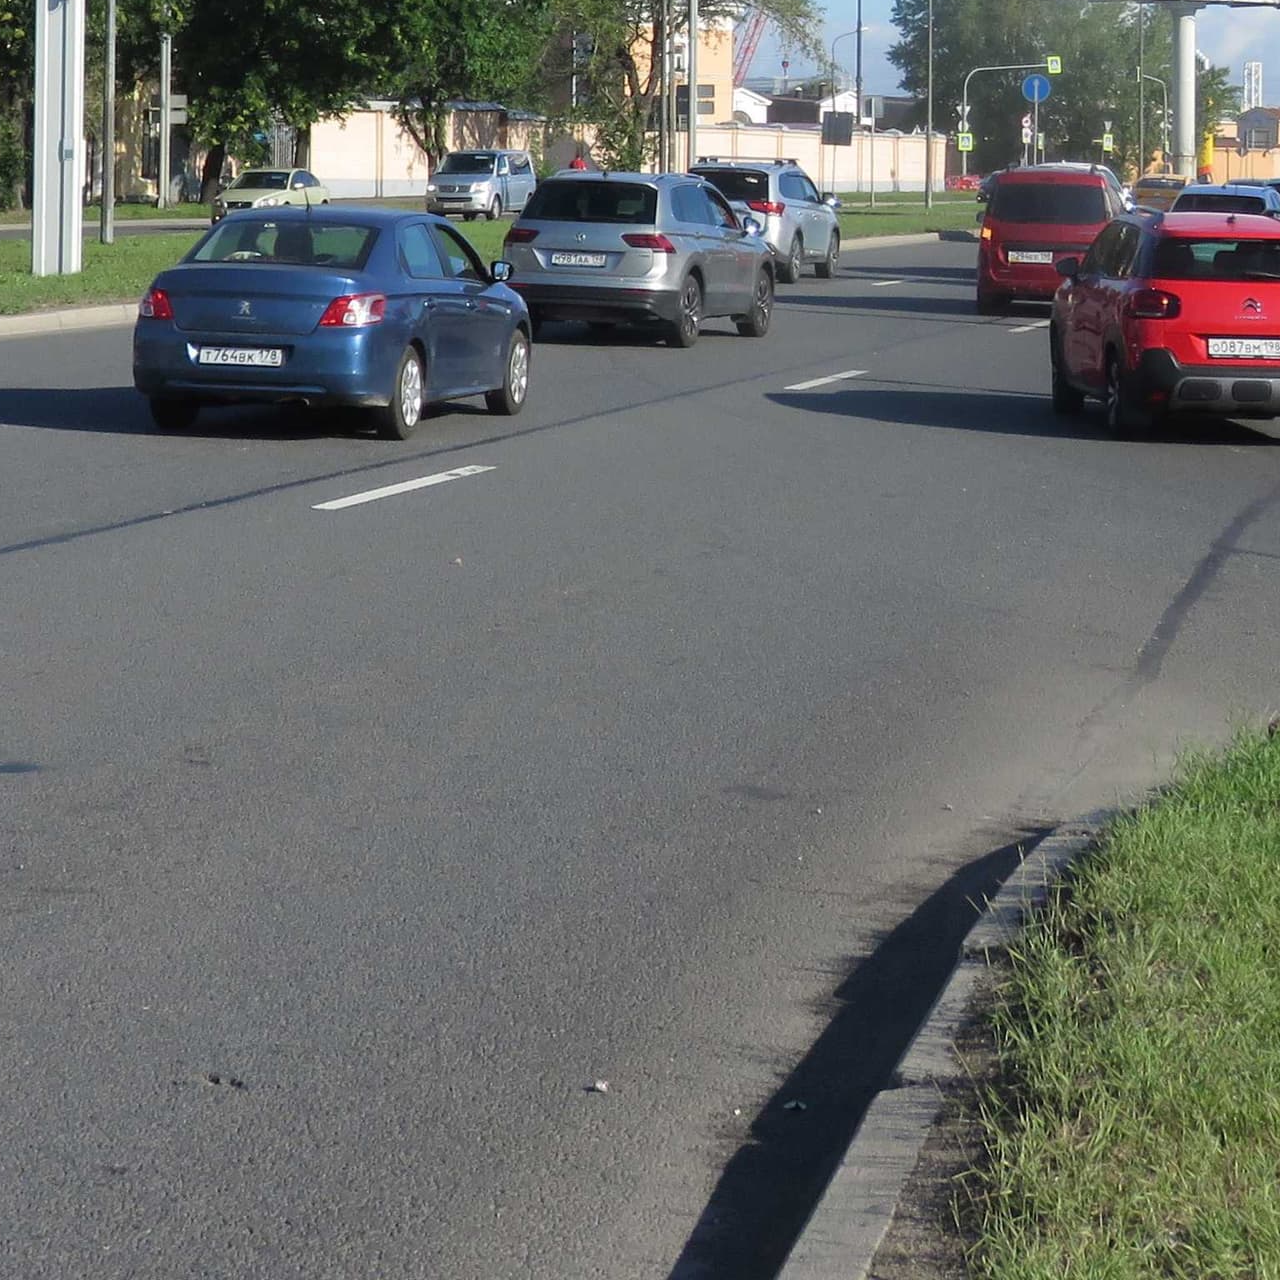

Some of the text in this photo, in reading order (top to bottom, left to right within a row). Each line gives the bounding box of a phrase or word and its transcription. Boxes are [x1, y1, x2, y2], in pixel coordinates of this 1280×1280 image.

[1212, 341, 1261, 353] О087ВМ
[204, 348, 278, 362] Т764ВК 178
